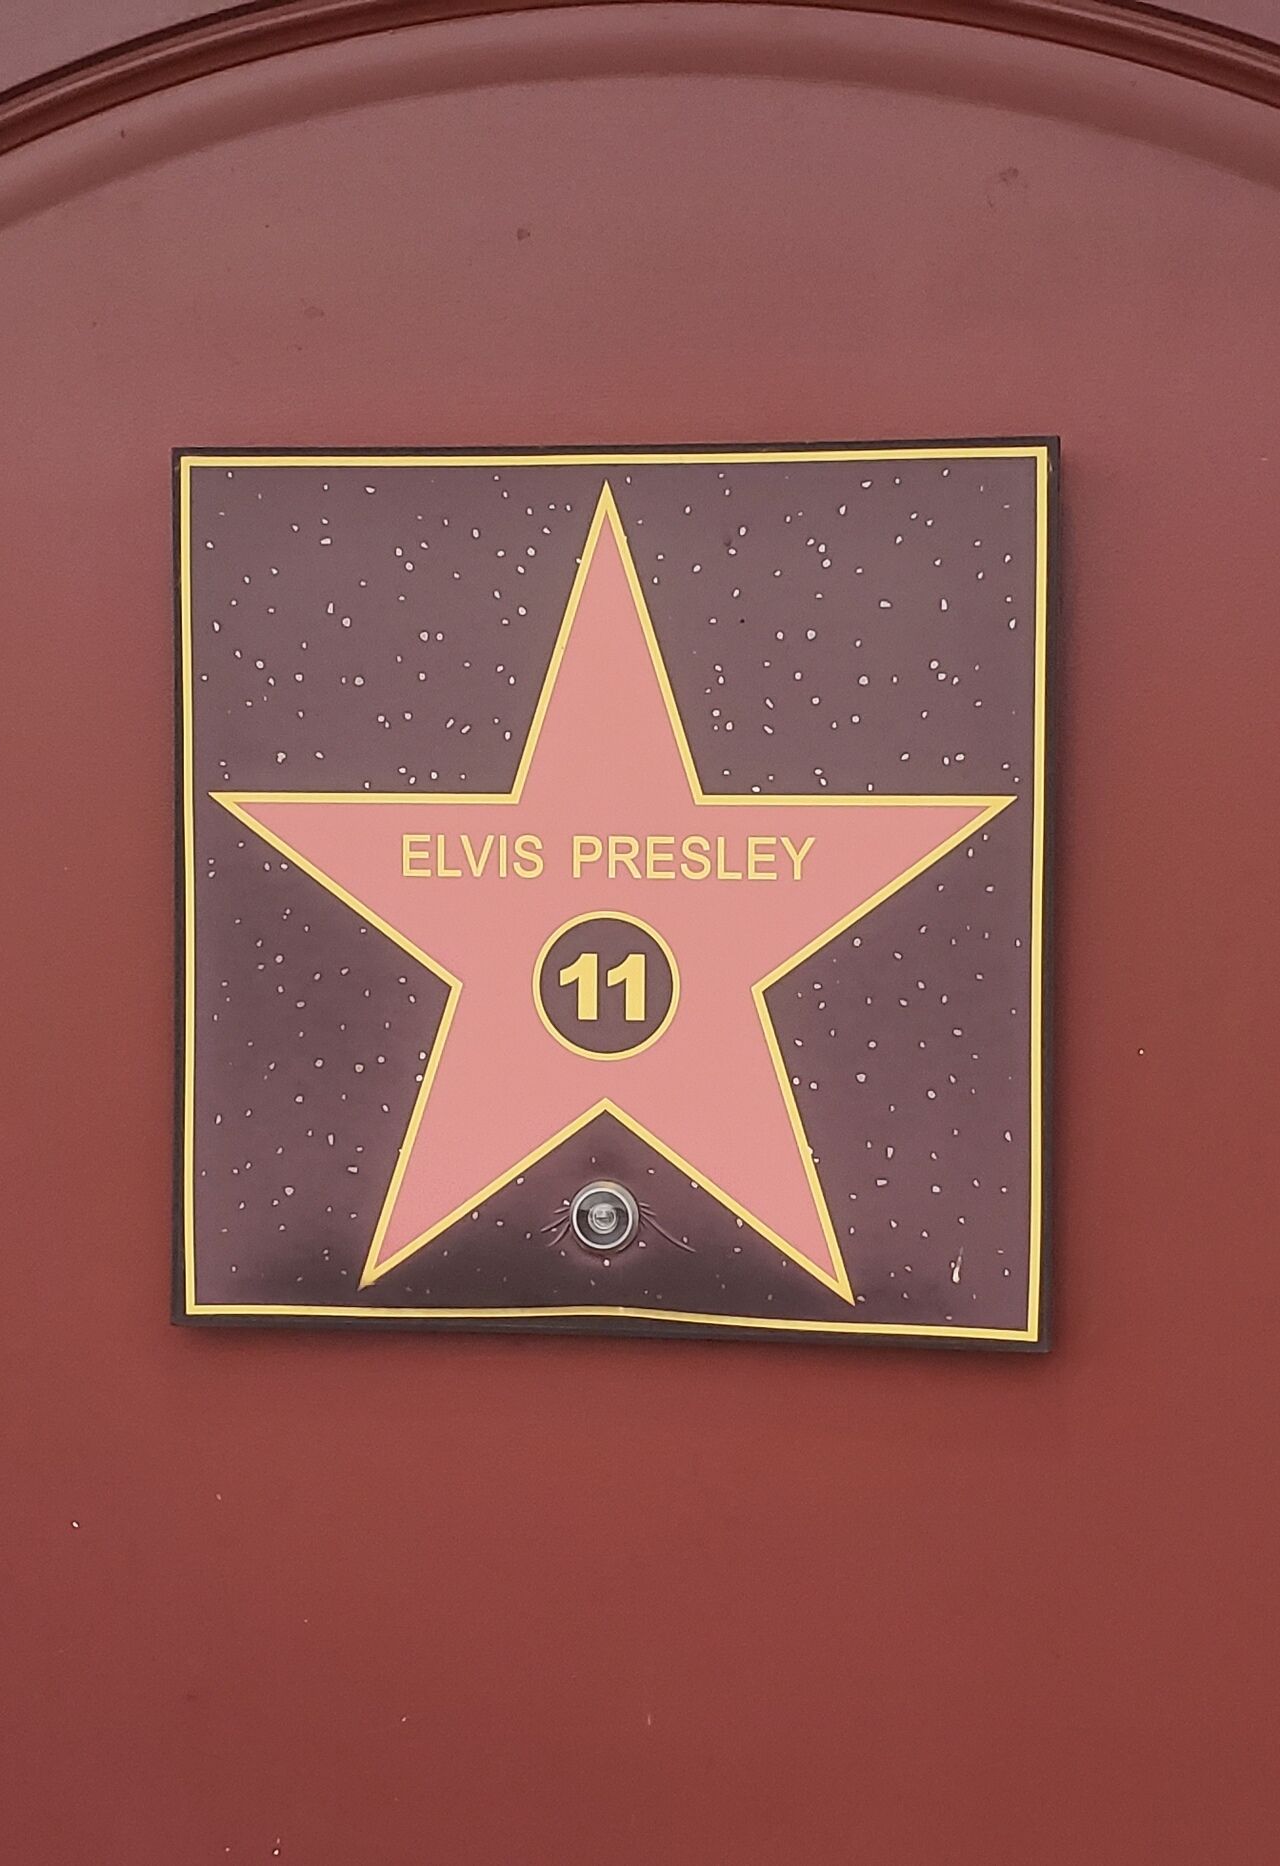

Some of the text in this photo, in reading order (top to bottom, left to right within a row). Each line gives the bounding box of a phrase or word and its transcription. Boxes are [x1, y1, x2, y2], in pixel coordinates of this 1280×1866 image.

[401, 834, 816, 881] ELVIS PRESLEY
[558, 953, 646, 1022] 11
